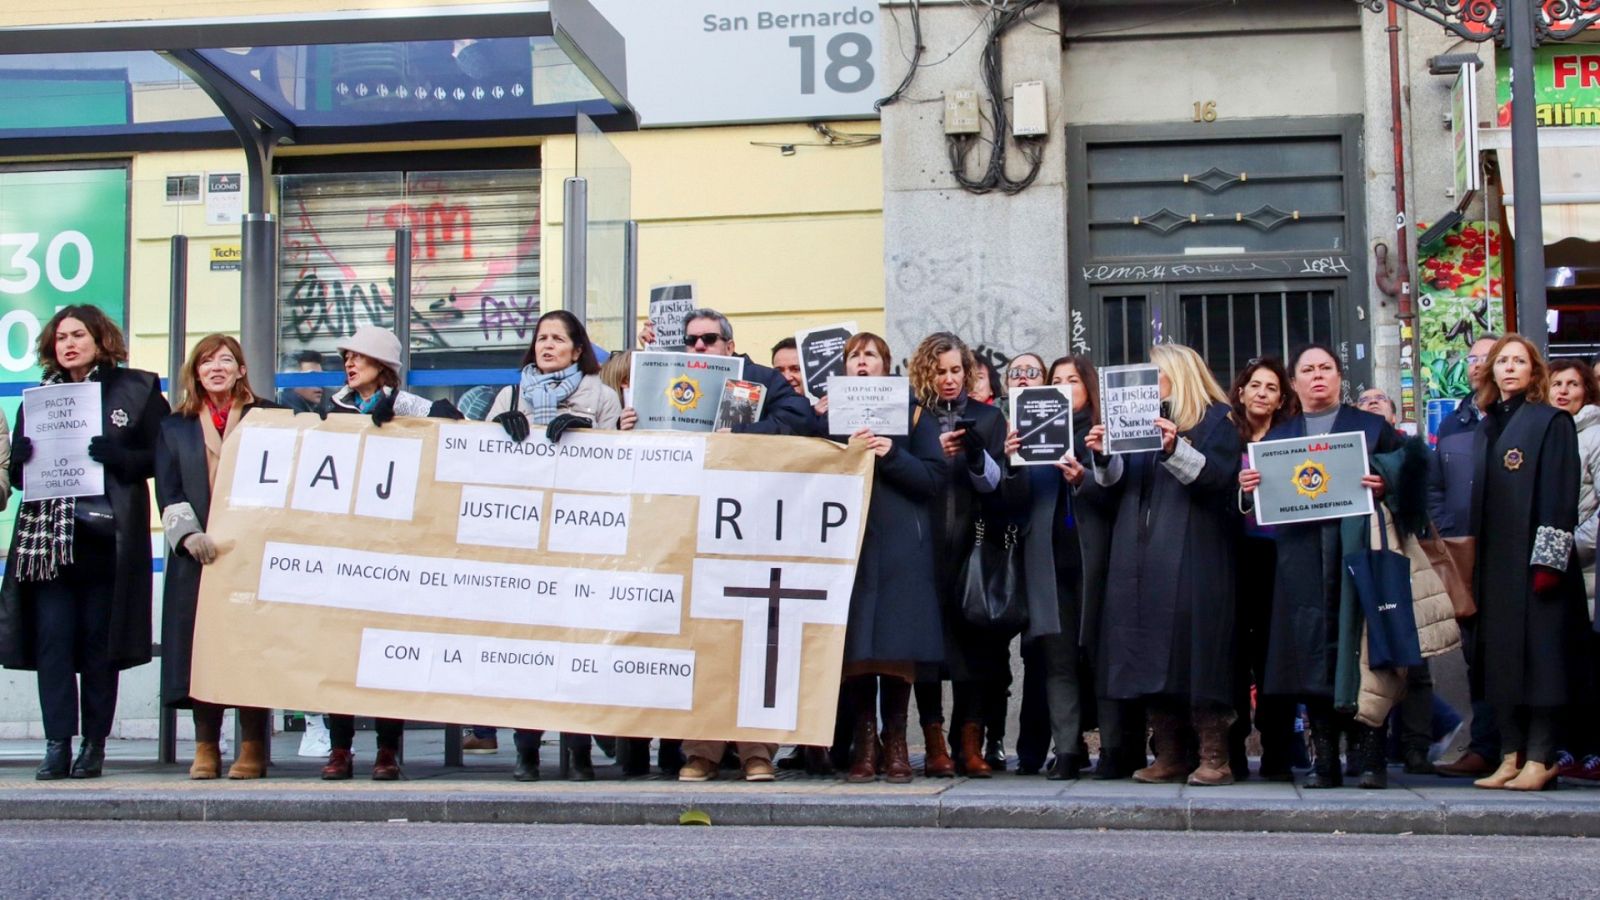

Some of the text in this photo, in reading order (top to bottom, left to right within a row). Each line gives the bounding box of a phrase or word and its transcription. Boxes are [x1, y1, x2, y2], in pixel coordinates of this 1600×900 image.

[703, 6, 874, 32] San Bernardo
[789, 32, 875, 94] 18
[1192, 100, 1218, 122] 16
[1121, 387, 1159, 403] justicia
[45, 397, 76, 408] PACTA
[47, 409, 72, 421] SUNT
[678, 416, 714, 426] INDEFINID
[36, 420, 88, 433] SERVANDA
[445, 437, 693, 462] SIN LETRADOS ADMON DE JUSTICIA
[54, 458, 68, 467] LO
[41, 467, 85, 479] PACTADO
[45, 479, 80, 489] OBLIGA
[1279, 500, 1353, 513] HUELGA INDEFINIDA
[461, 501, 626, 527] JUSTICIA PARADA
[269, 556, 676, 603] POR LA INACCIÓN DEL MINISTERIO DE IN- JUSTICIA
[384, 644, 692, 678] CON LA BENDICIÓN DEL GOBIERNO
